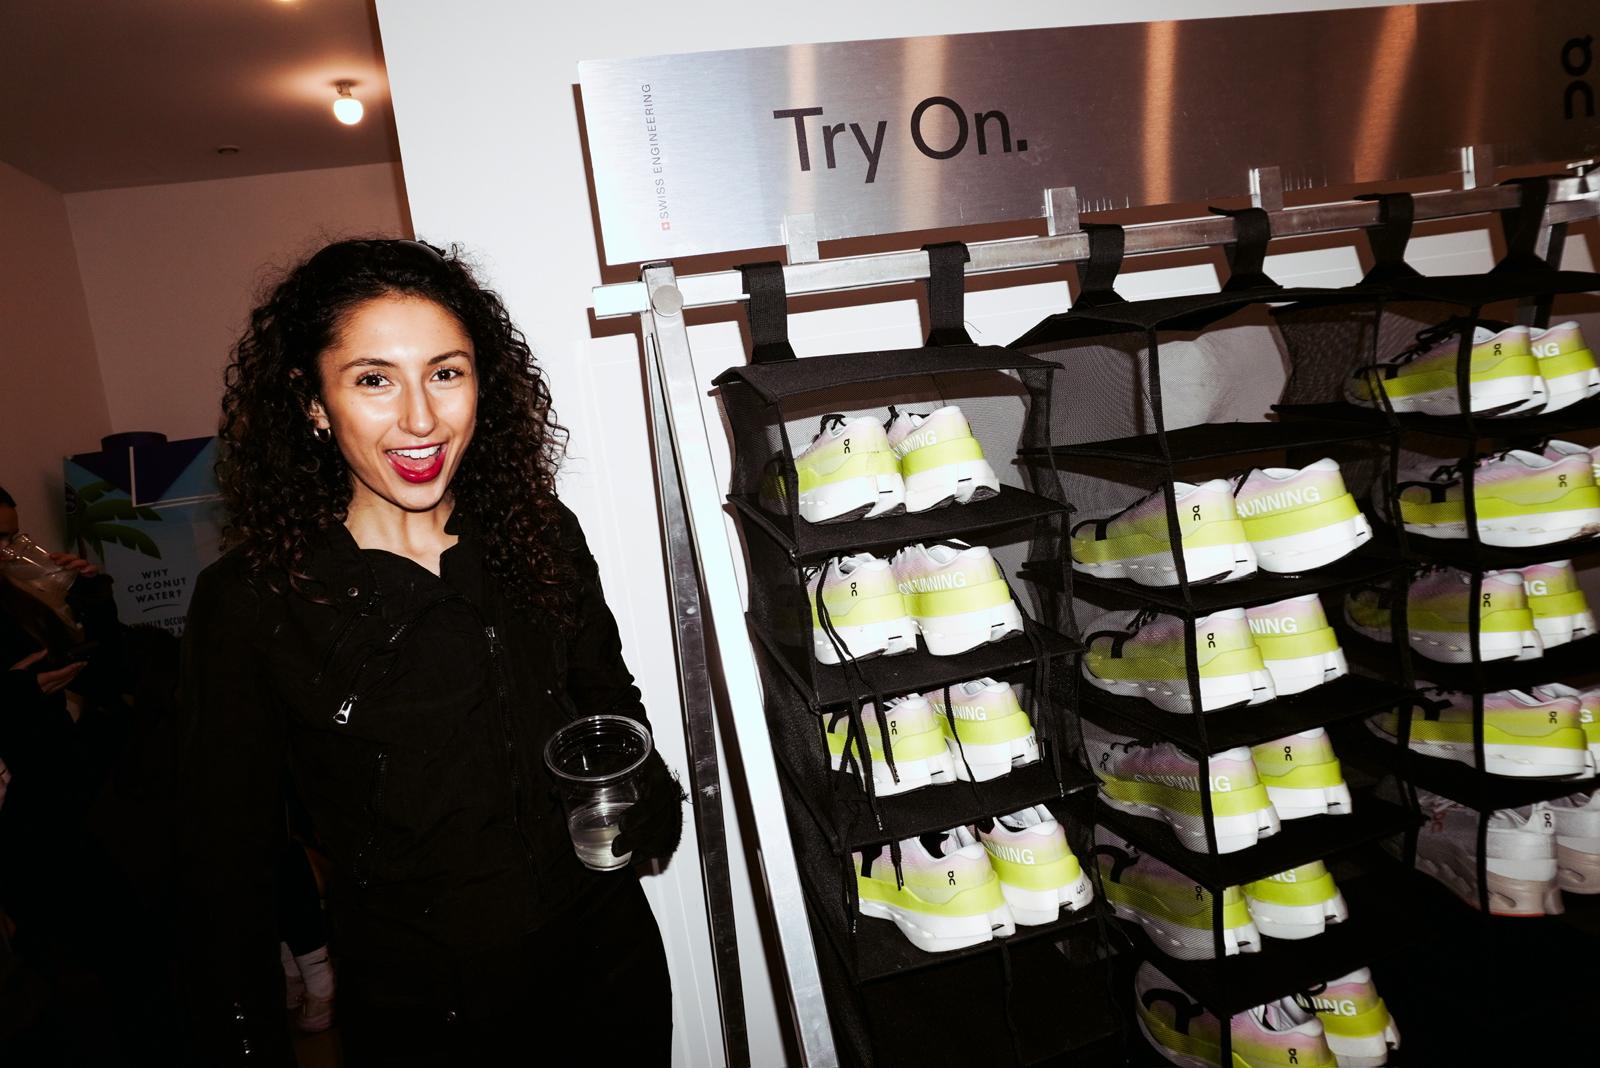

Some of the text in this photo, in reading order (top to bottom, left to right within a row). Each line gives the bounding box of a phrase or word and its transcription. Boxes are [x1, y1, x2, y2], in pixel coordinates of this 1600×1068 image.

[772, 95, 1029, 185] Try On.
[640, 82, 671, 219] SWISS ENGINEERING
[142, 568, 168, 579] WHY
[127, 577, 187, 593] COCONUT
[135, 589, 182, 603] WATER?
